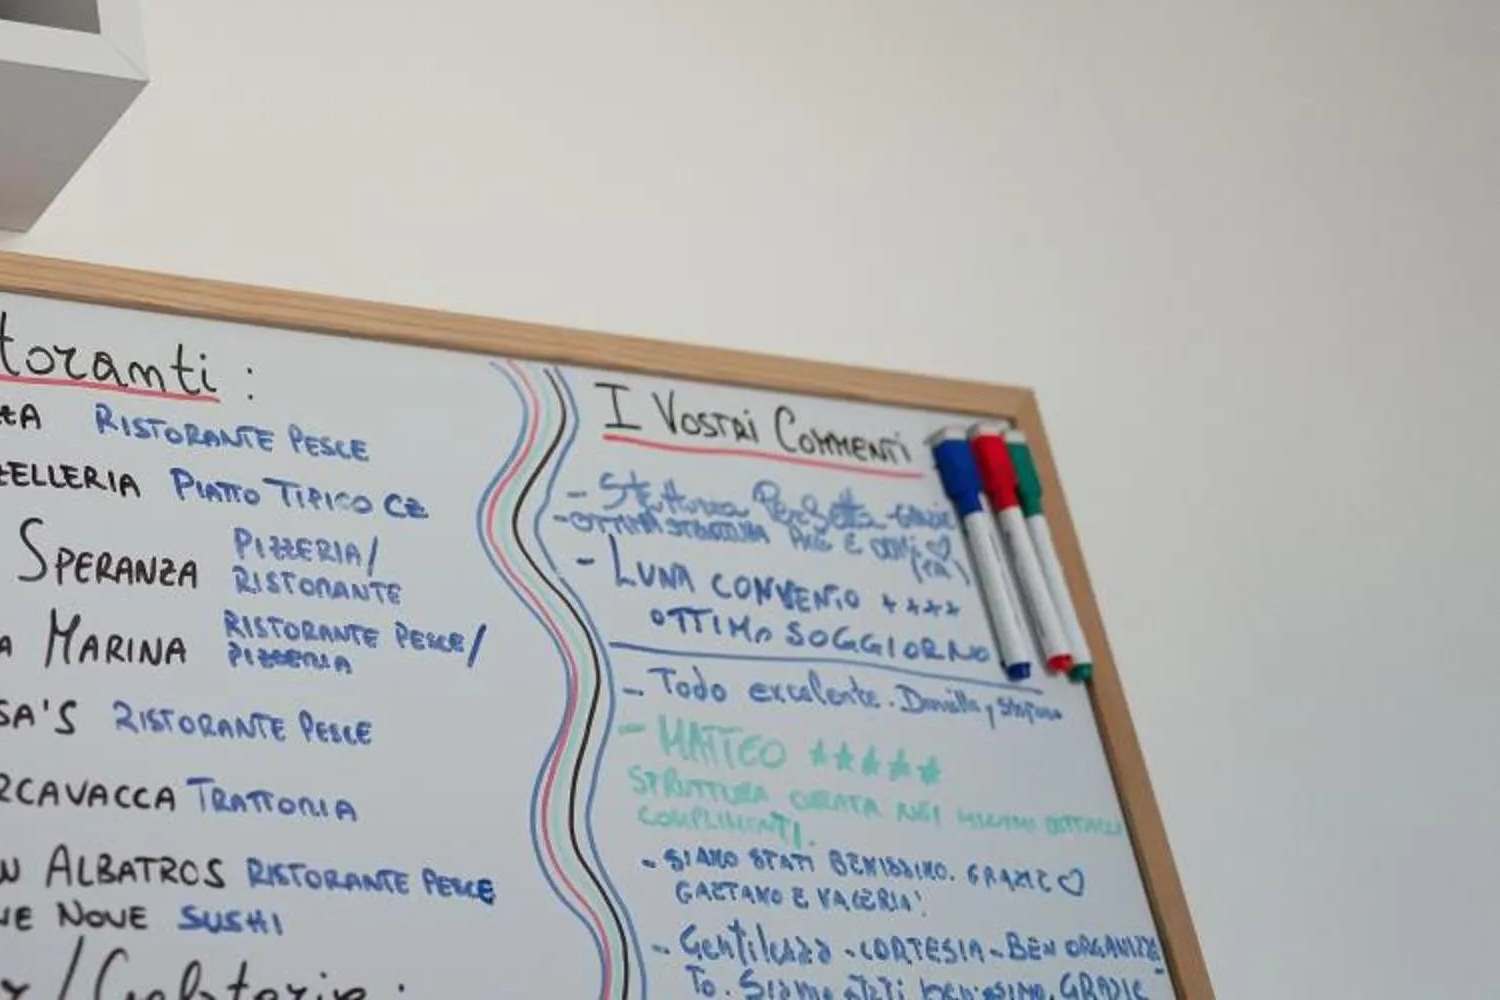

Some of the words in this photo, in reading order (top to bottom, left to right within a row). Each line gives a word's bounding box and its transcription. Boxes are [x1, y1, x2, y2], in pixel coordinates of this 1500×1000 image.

[95, 402, 275, 452] RISTORANTE
[288, 423, 369, 462] PESCE
[169, 467, 261, 507] PIATTO
[262, 476, 373, 515] TIPICO
[232, 565, 403, 606] RISTORANTE
[608, 533, 695, 594] LUNA
[44, 607, 188, 668] MARINA
[223, 609, 380, 649] RISTORANTE
[785, 621, 991, 664] SOGGIORNO
[112, 700, 287, 742] RISTORANTE
[298, 710, 373, 745] PESCE
[185, 777, 358, 823] TRATTORIA
[45, 843, 226, 890] ALBATROS
[246, 857, 410, 895] RISTORANTE
[421, 867, 497, 906] PESCE
[56, 899, 148, 930] NOVE
[177, 904, 284, 936] SUSHI
